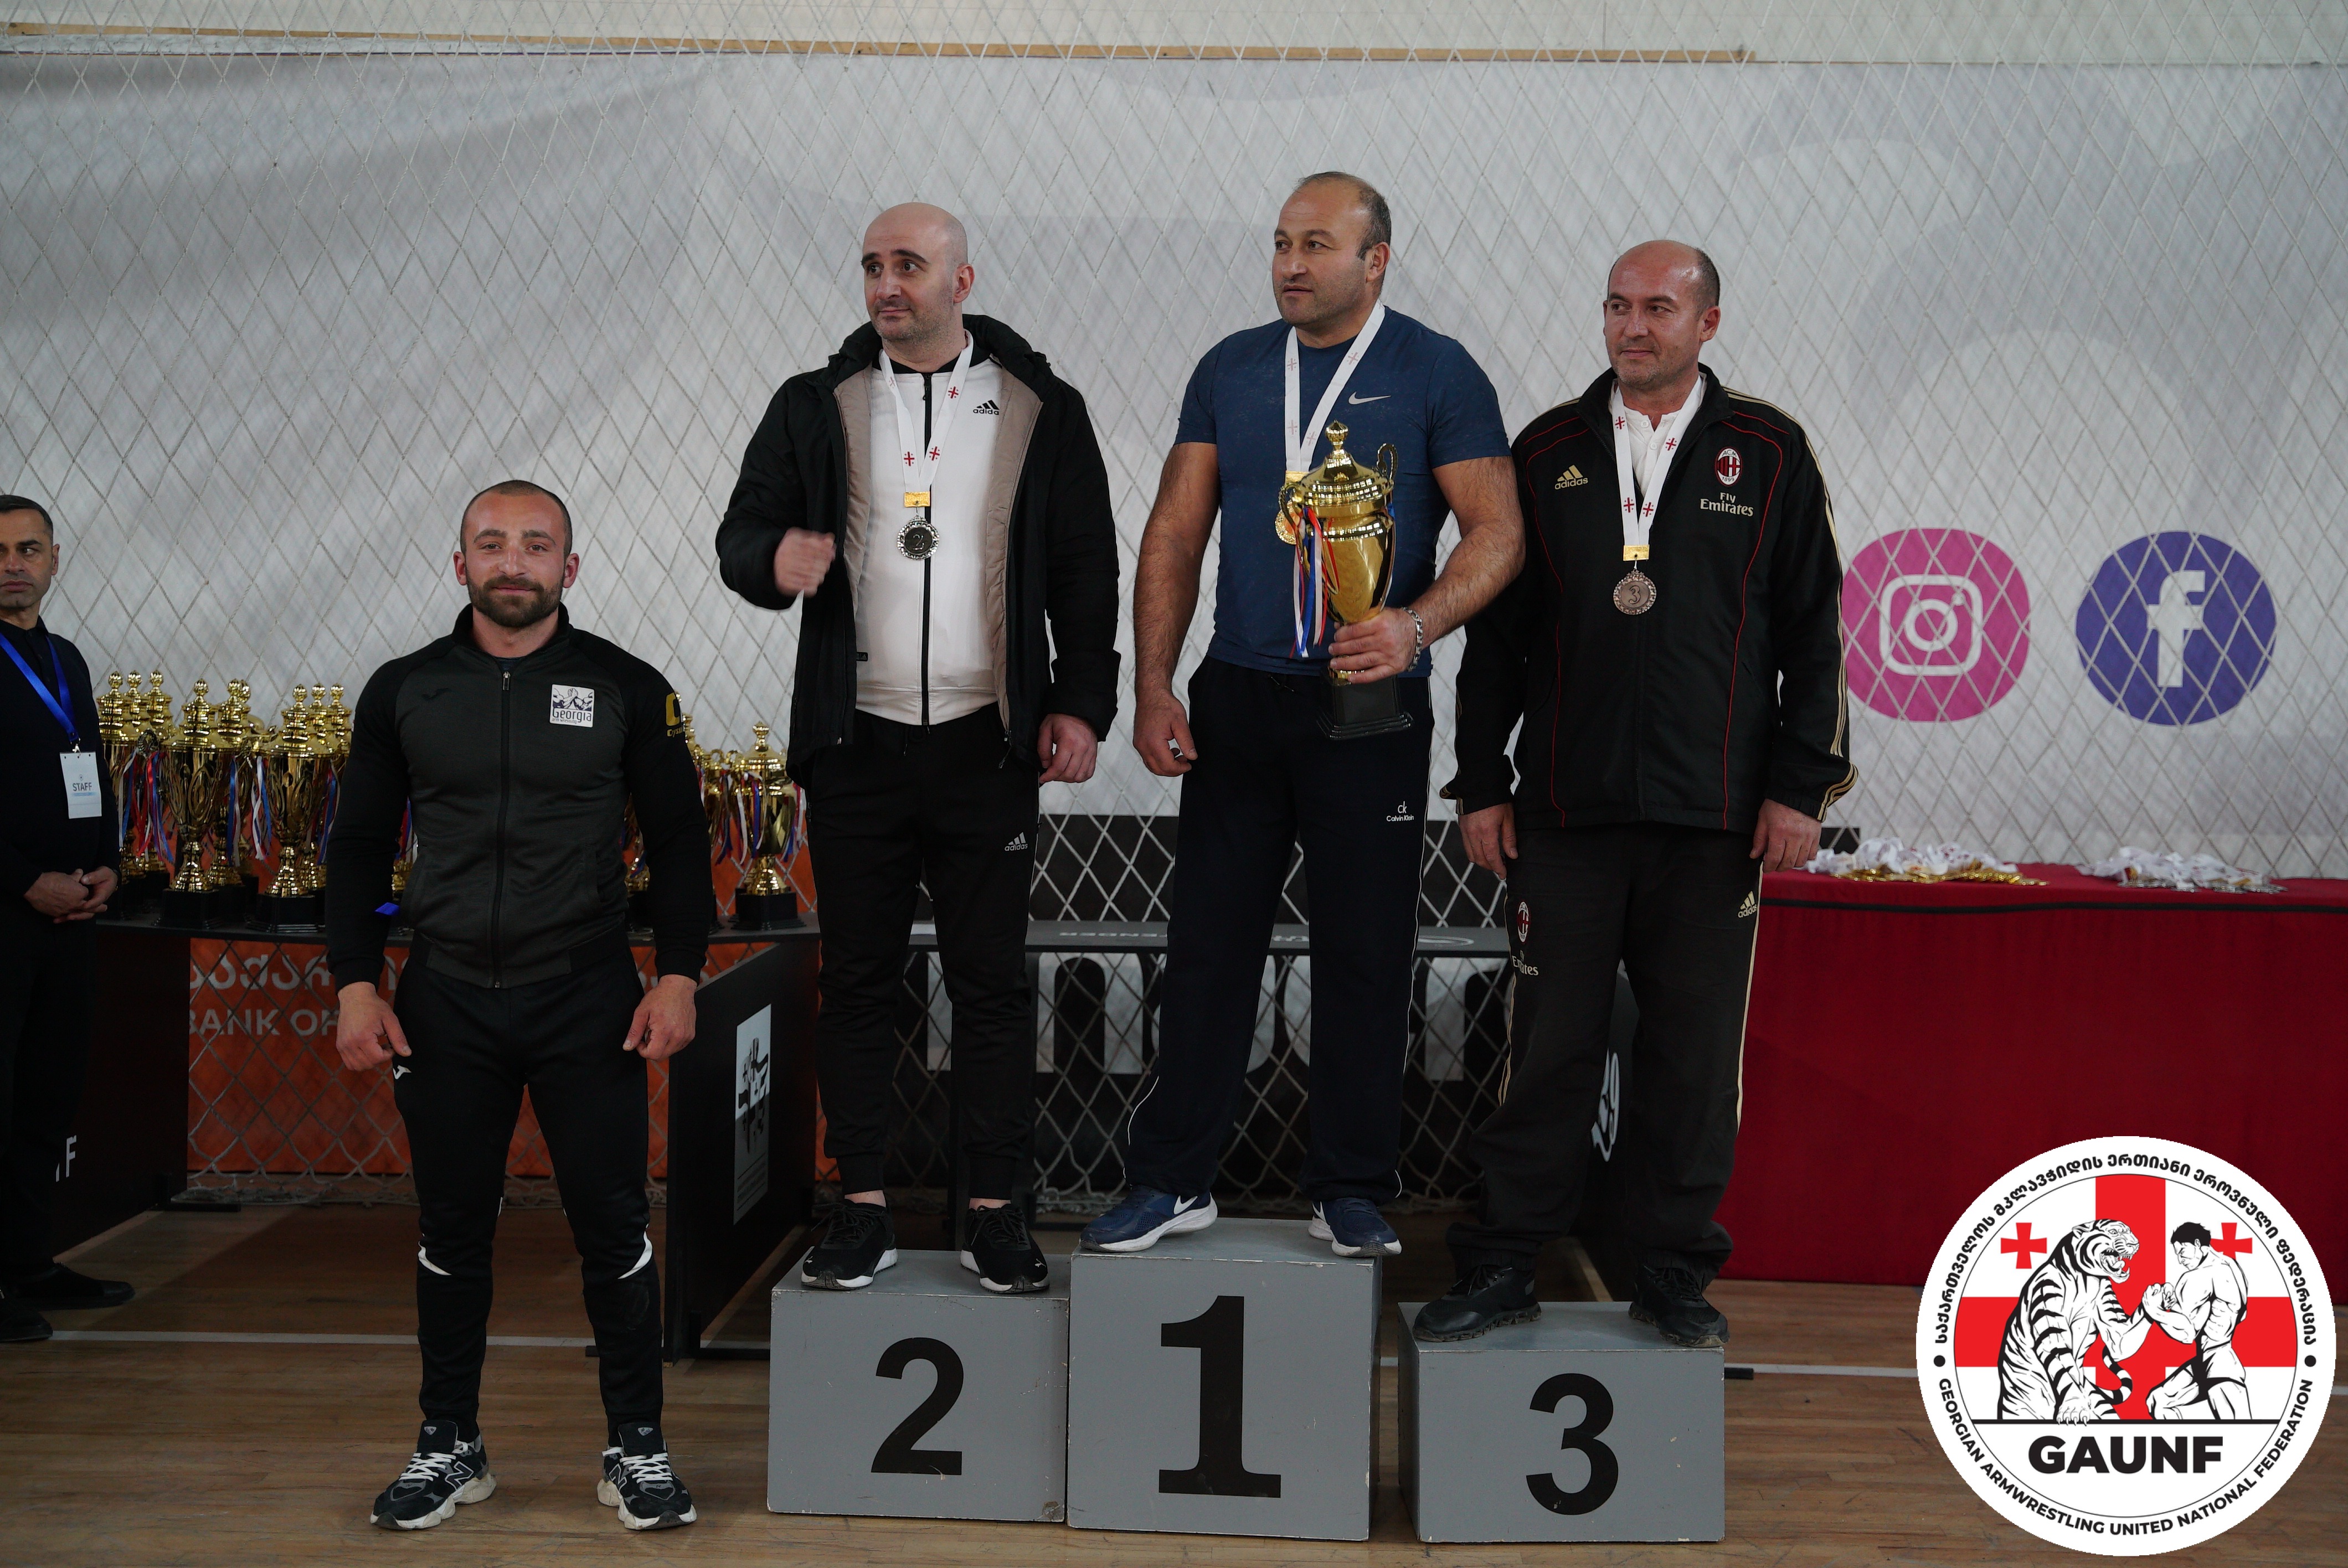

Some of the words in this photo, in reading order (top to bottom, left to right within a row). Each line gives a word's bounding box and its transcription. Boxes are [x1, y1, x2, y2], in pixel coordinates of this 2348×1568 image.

[1554, 478, 1589, 490] adidas
[1720, 492, 1736, 504] Fly
[1700, 498, 1754, 517] Emirates
[1629, 585, 1641, 605] 3
[552, 708, 592, 723] Georgia
[73, 782, 92, 792] STAFF
[1004, 843, 1028, 852] adidas
[1159, 1296, 1281, 1498] 1
[871, 1338, 964, 1475] 2
[1526, 1373, 1618, 1515] 3
